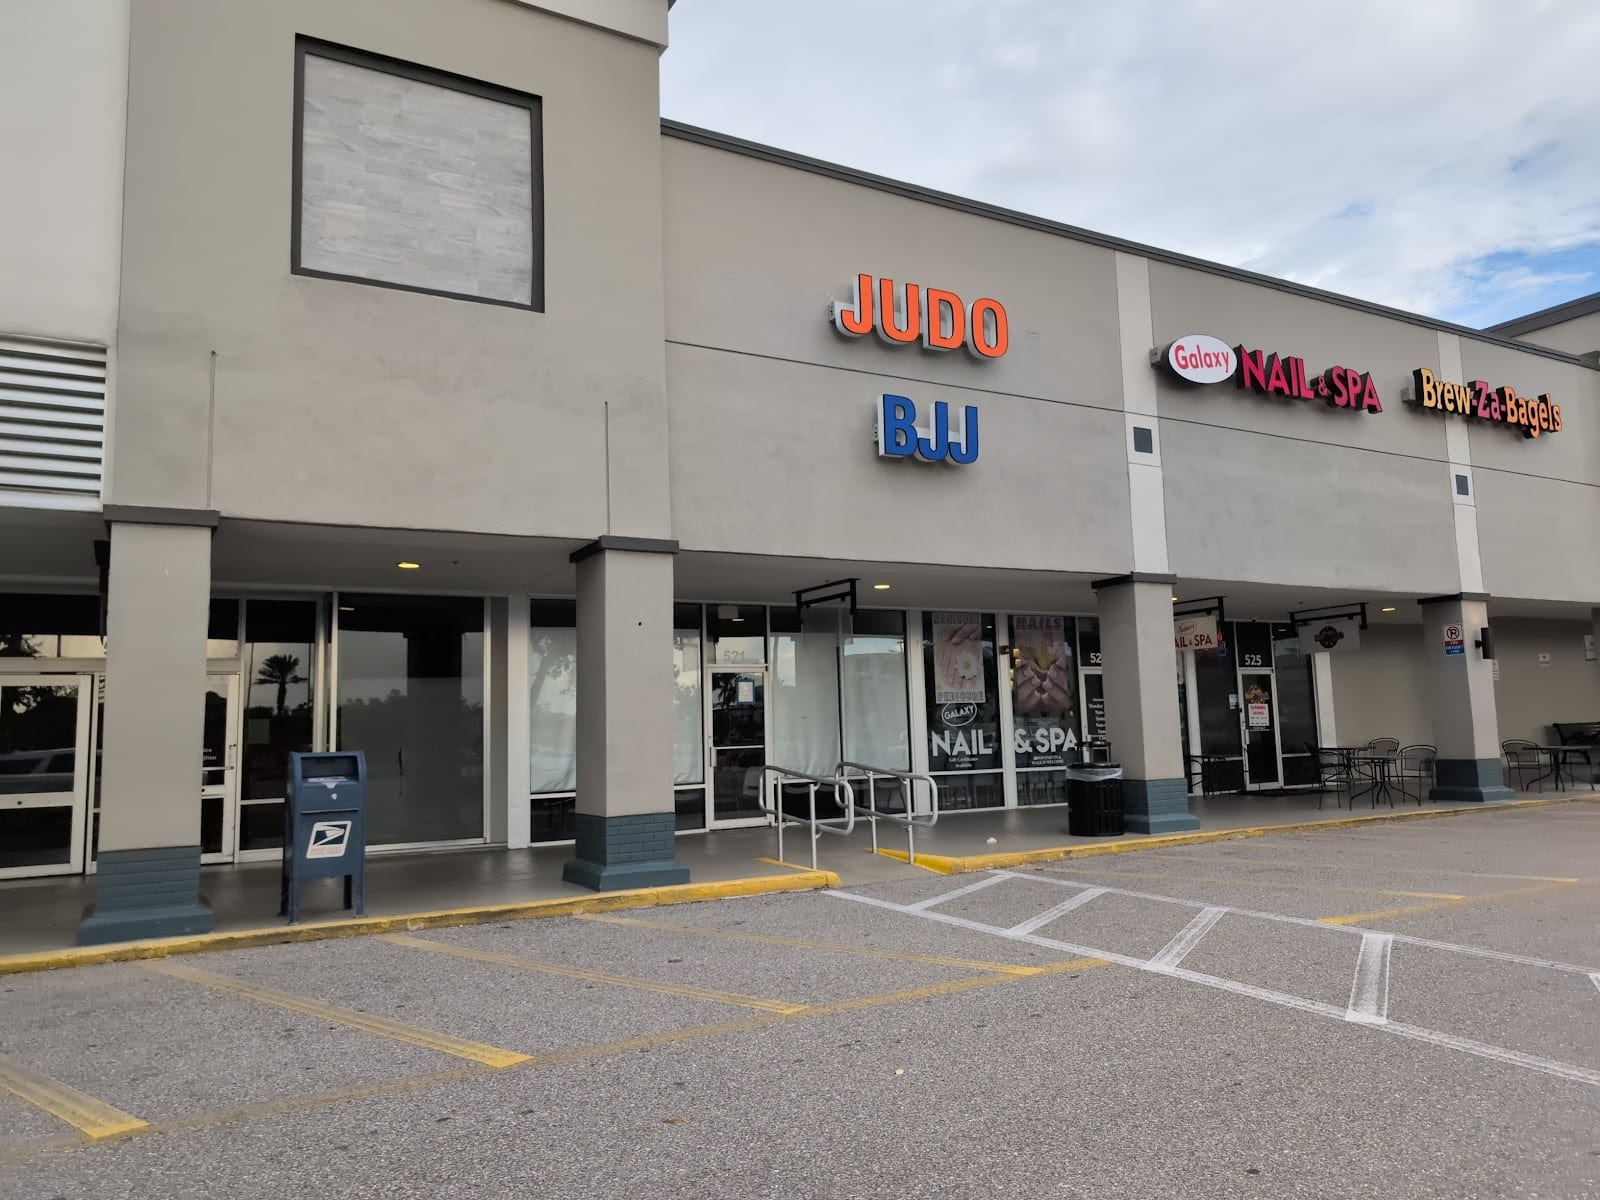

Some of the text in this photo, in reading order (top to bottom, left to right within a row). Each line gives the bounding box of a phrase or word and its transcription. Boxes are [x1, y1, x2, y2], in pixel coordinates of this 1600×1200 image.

[837, 273, 1009, 359] JUDO
[1174, 344, 1230, 373] Galaxy
[1237, 343, 1383, 413] NAIL & SPA
[880, 393, 979, 464] BJJ
[1175, 635, 1188, 648] AIL
[1194, 633, 1213, 647] SPA
[723, 650, 745, 664] 521
[1090, 652, 1103, 664] 52
[1245, 655, 1262, 666] 525
[943, 705, 975, 720] GALAXY
[931, 728, 993, 757] NAIL
[1014, 727, 1078, 754] & SPA
